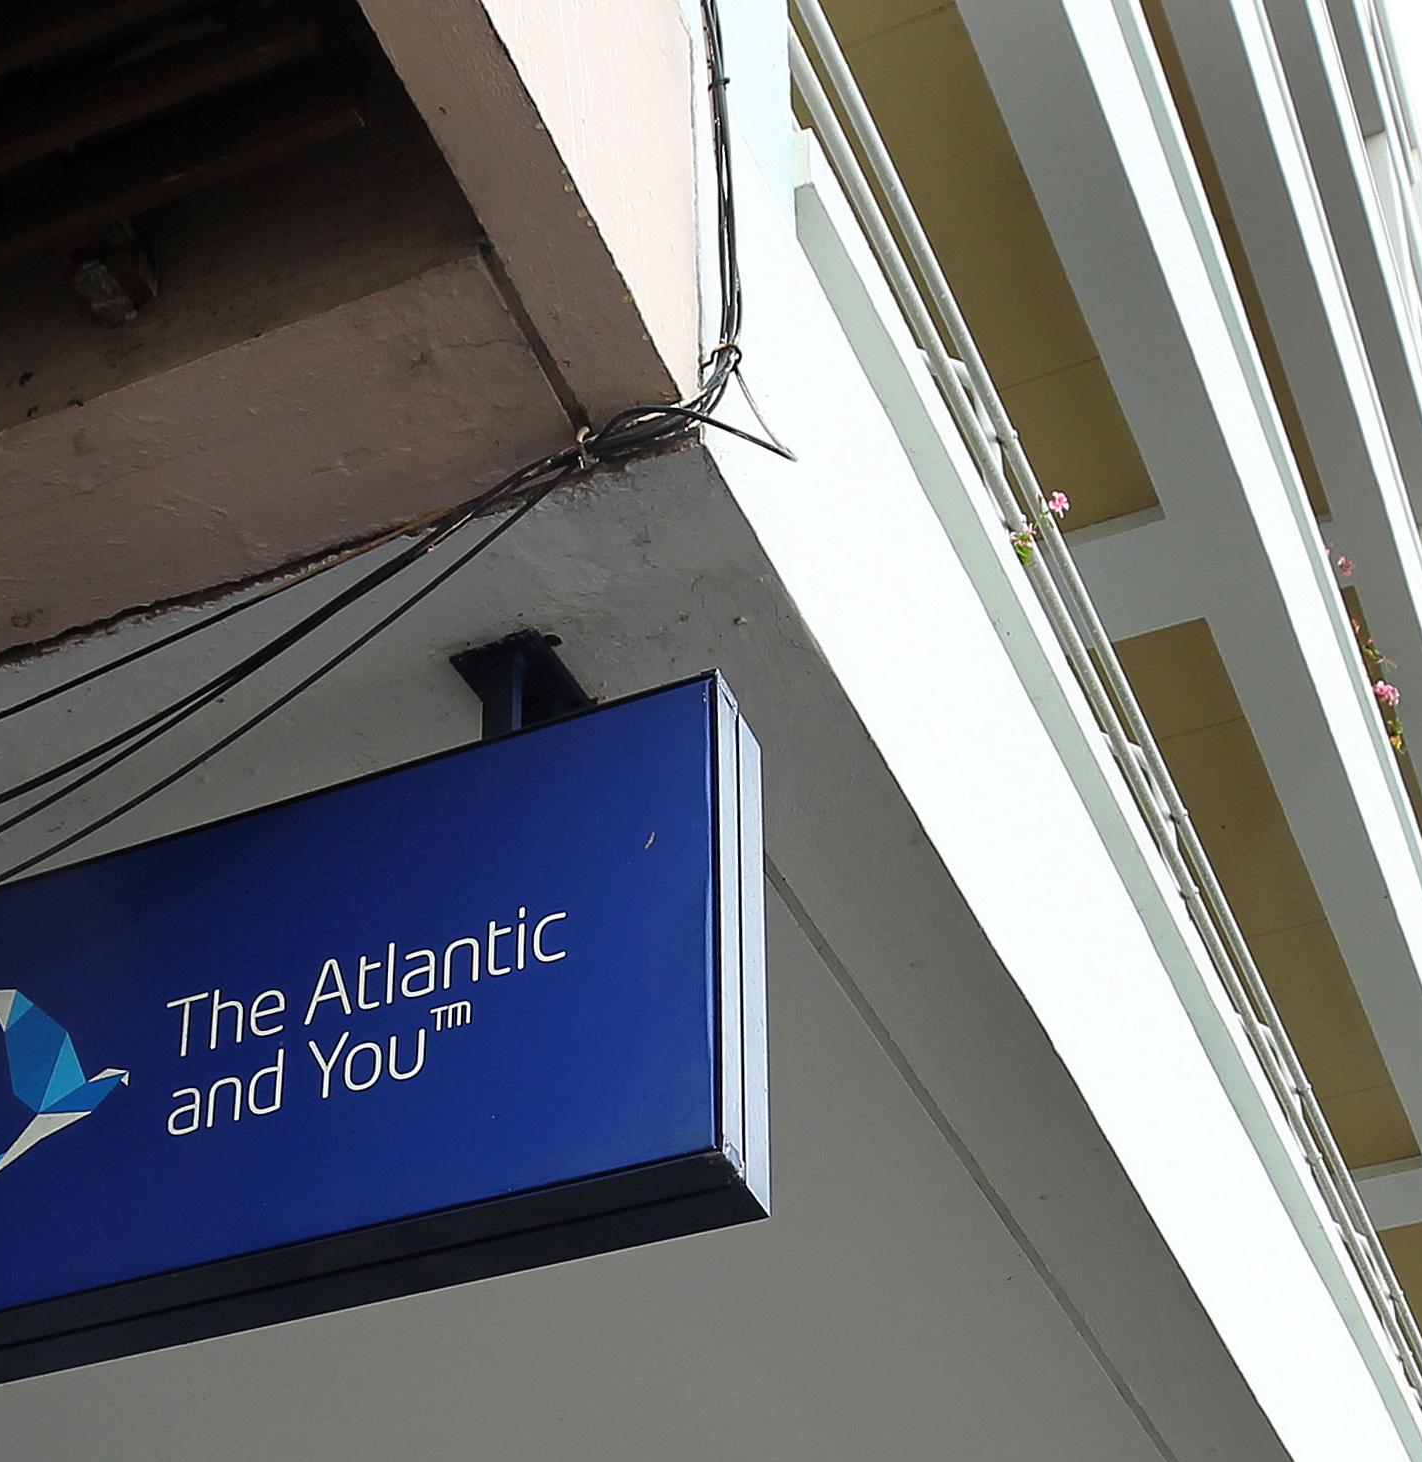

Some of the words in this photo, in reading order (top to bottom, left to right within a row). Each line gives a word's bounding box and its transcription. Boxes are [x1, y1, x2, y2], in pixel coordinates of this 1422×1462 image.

[167, 989, 286, 1057] The
[304, 906, 568, 1026] Atlantic
[167, 1048, 285, 1137] and
